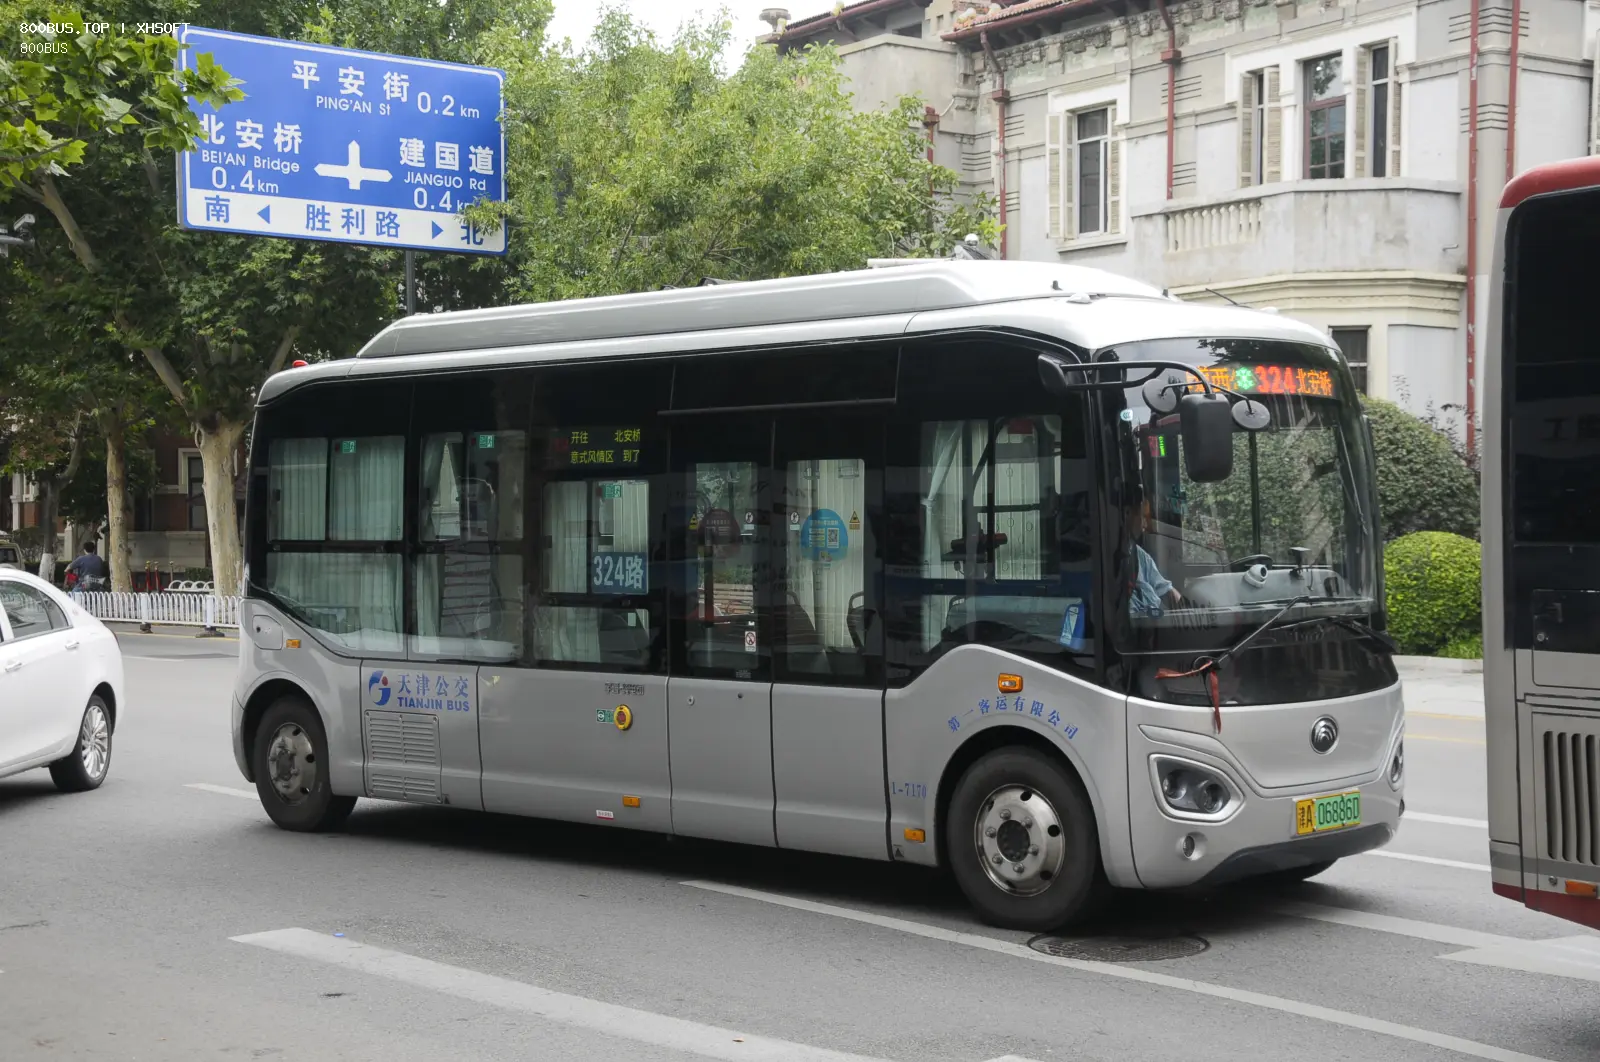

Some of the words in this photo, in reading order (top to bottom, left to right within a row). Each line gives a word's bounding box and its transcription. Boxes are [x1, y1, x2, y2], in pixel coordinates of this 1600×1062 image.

[292, 60, 410, 103] 平安街
[316, 96, 372, 114] PING'AN
[379, 103, 391, 116] St
[417, 92, 455, 117] 0.2
[460, 104, 480, 119] km
[199, 113, 303, 154] 北安桥
[202, 149, 246, 167] BEI'AN
[253, 155, 300, 174] Bridge
[400, 137, 494, 175] 建国道
[212, 166, 255, 192] 0.4
[257, 179, 279, 193] km
[404, 171, 463, 189] JIANGUO
[469, 178, 487, 190] Rd
[413, 187, 452, 211] 0.4
[204, 194, 230, 224] 南
[305, 203, 400, 239] 胜利路
[1255, 364, 1297, 394] 324
[1296, 368, 1334, 396] 北安桥
[570, 431, 589, 445] 开往
[614, 428, 641, 443] 北安桥
[570, 449, 615, 464] 意式风情区
[623, 449, 640, 463] 到了
[593, 555, 644, 590] 324路
[397, 672, 469, 699] 天津公交
[397, 696, 443, 711] TIANJIN
[447, 699, 470, 712] BUS
[947, 695, 1079, 740] 第一客运有限公司
